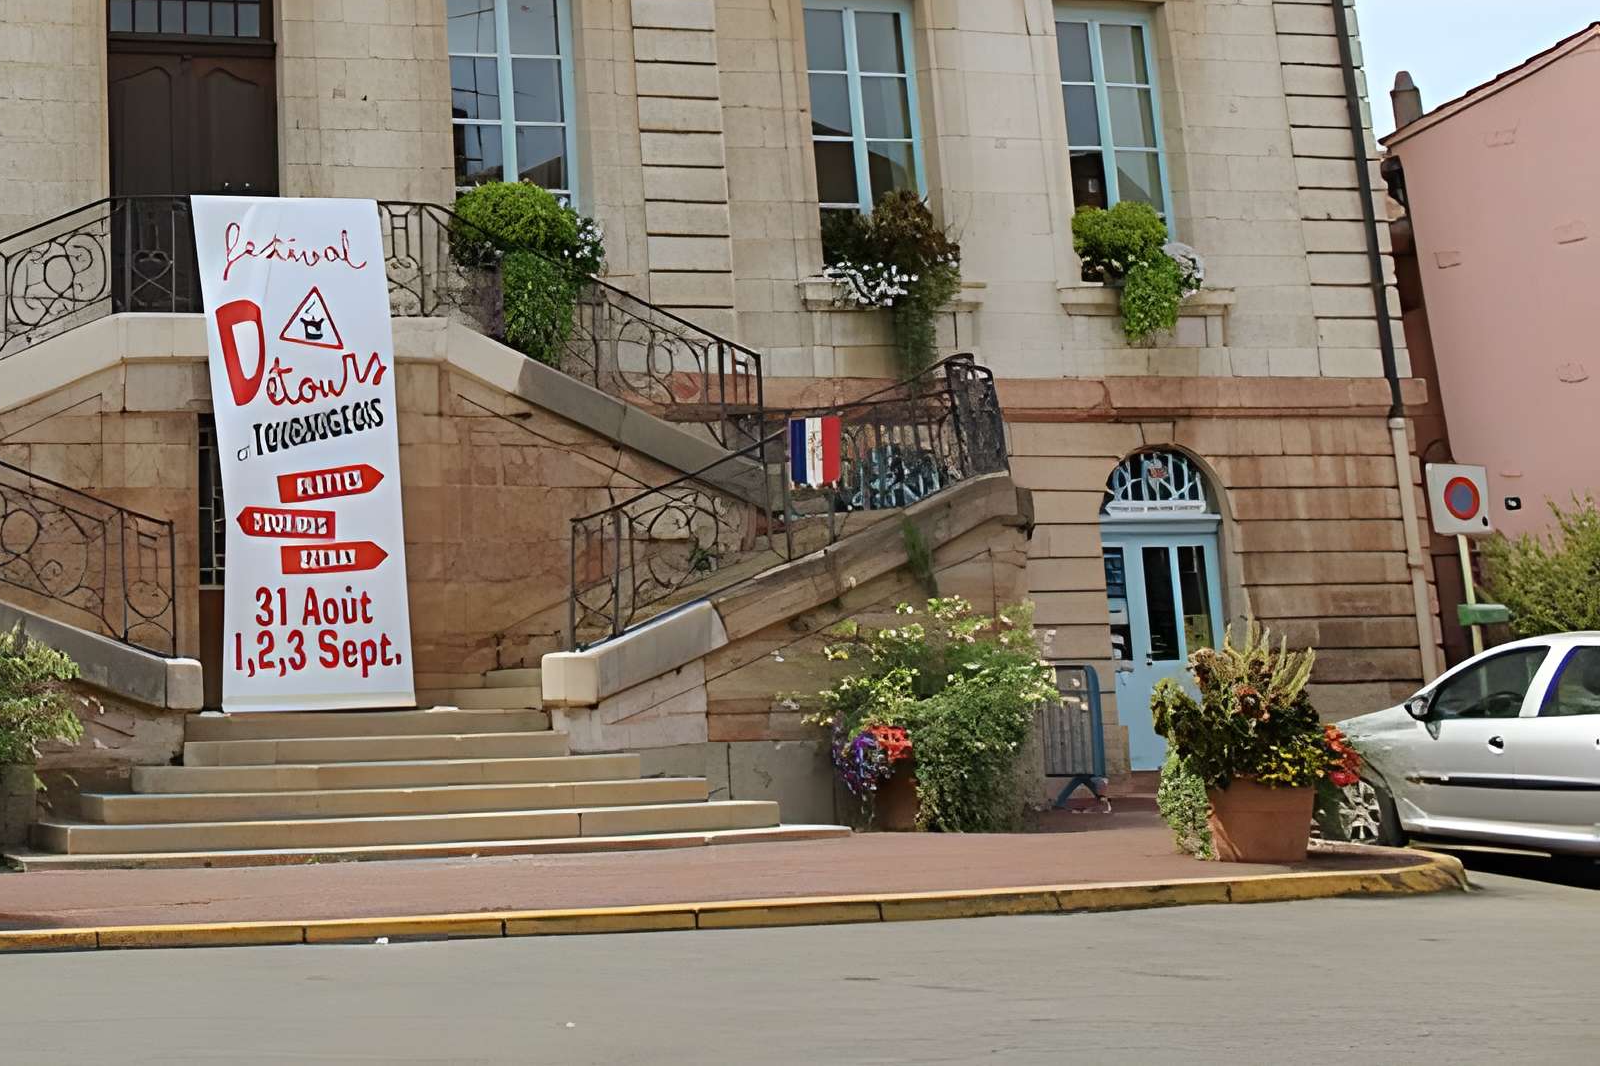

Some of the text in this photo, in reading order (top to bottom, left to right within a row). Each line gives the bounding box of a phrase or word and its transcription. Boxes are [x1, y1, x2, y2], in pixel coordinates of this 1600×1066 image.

[255, 587, 287, 626] 31
[235, 629, 402, 678] 1,2,3 Sept.
